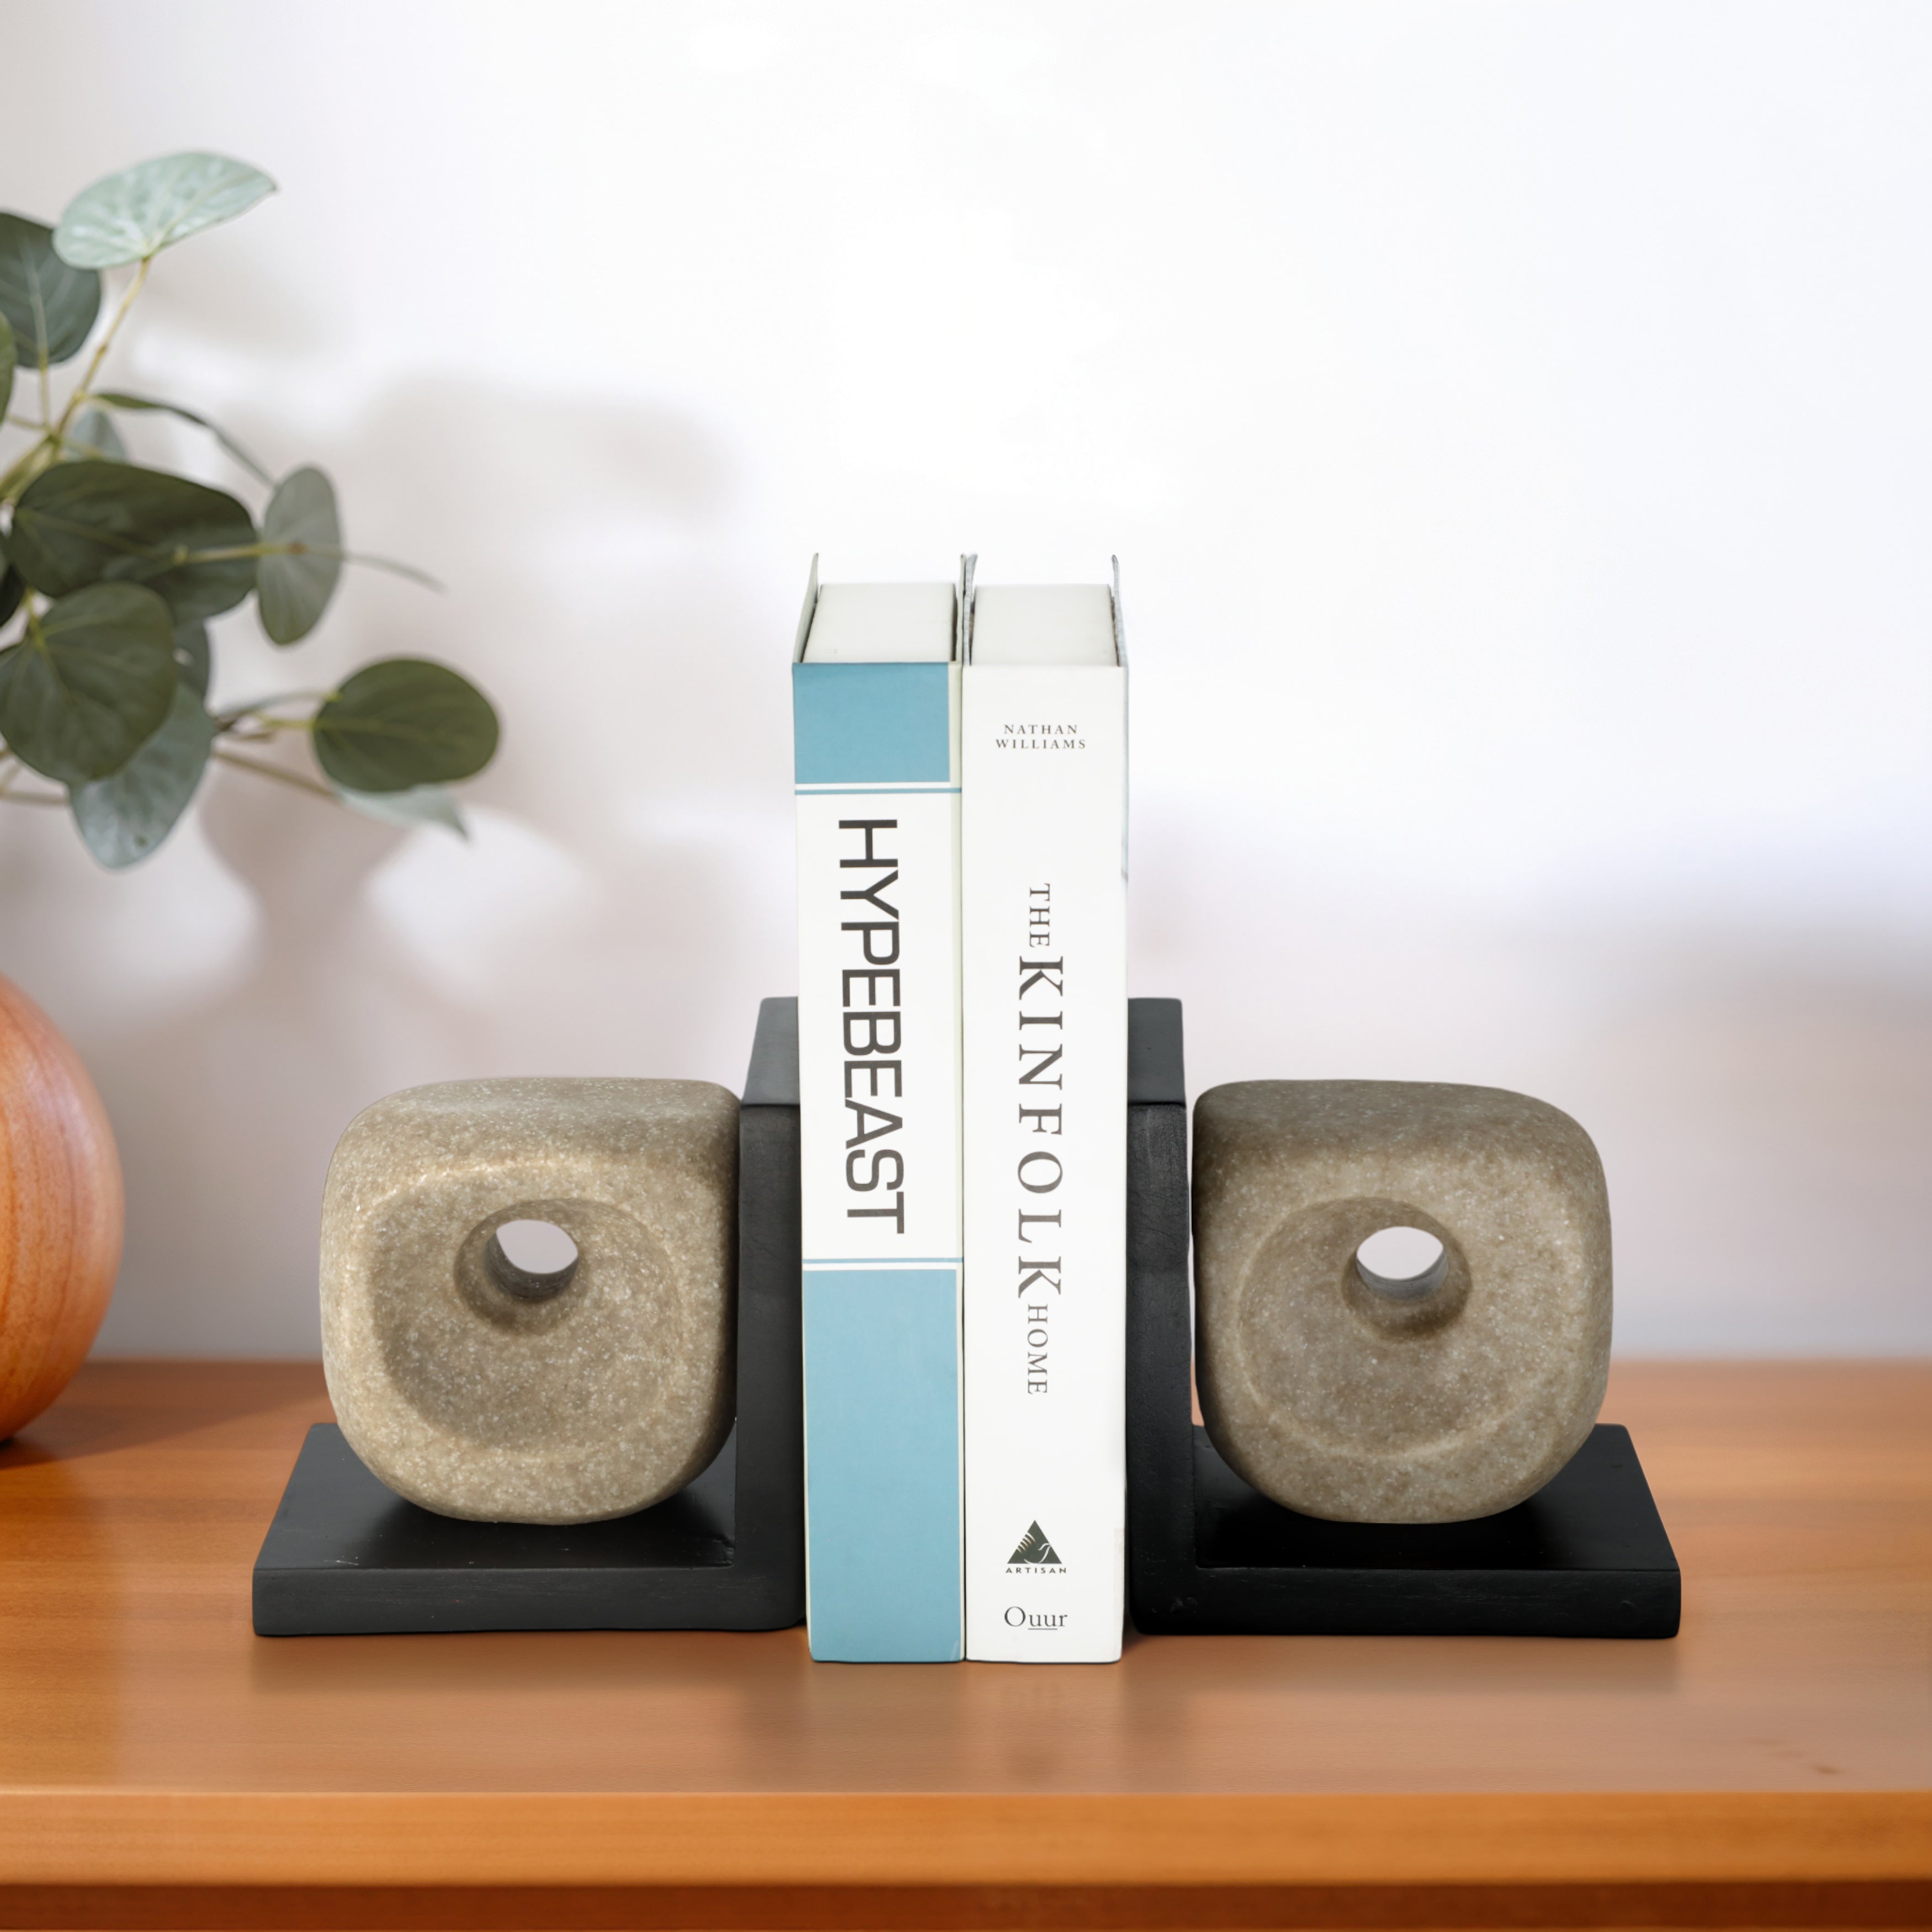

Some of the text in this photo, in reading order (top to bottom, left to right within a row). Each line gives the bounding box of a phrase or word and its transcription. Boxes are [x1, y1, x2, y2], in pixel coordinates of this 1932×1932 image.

[1004, 724, 1078, 735] NATHAN
[995, 739, 1086, 749] WILLIAMS
[838, 819, 905, 1235] HYPEBEAST
[1017, 883, 1064, 1394] THE KINFOLK HOME
[1004, 1606, 1068, 1627] Ouur
